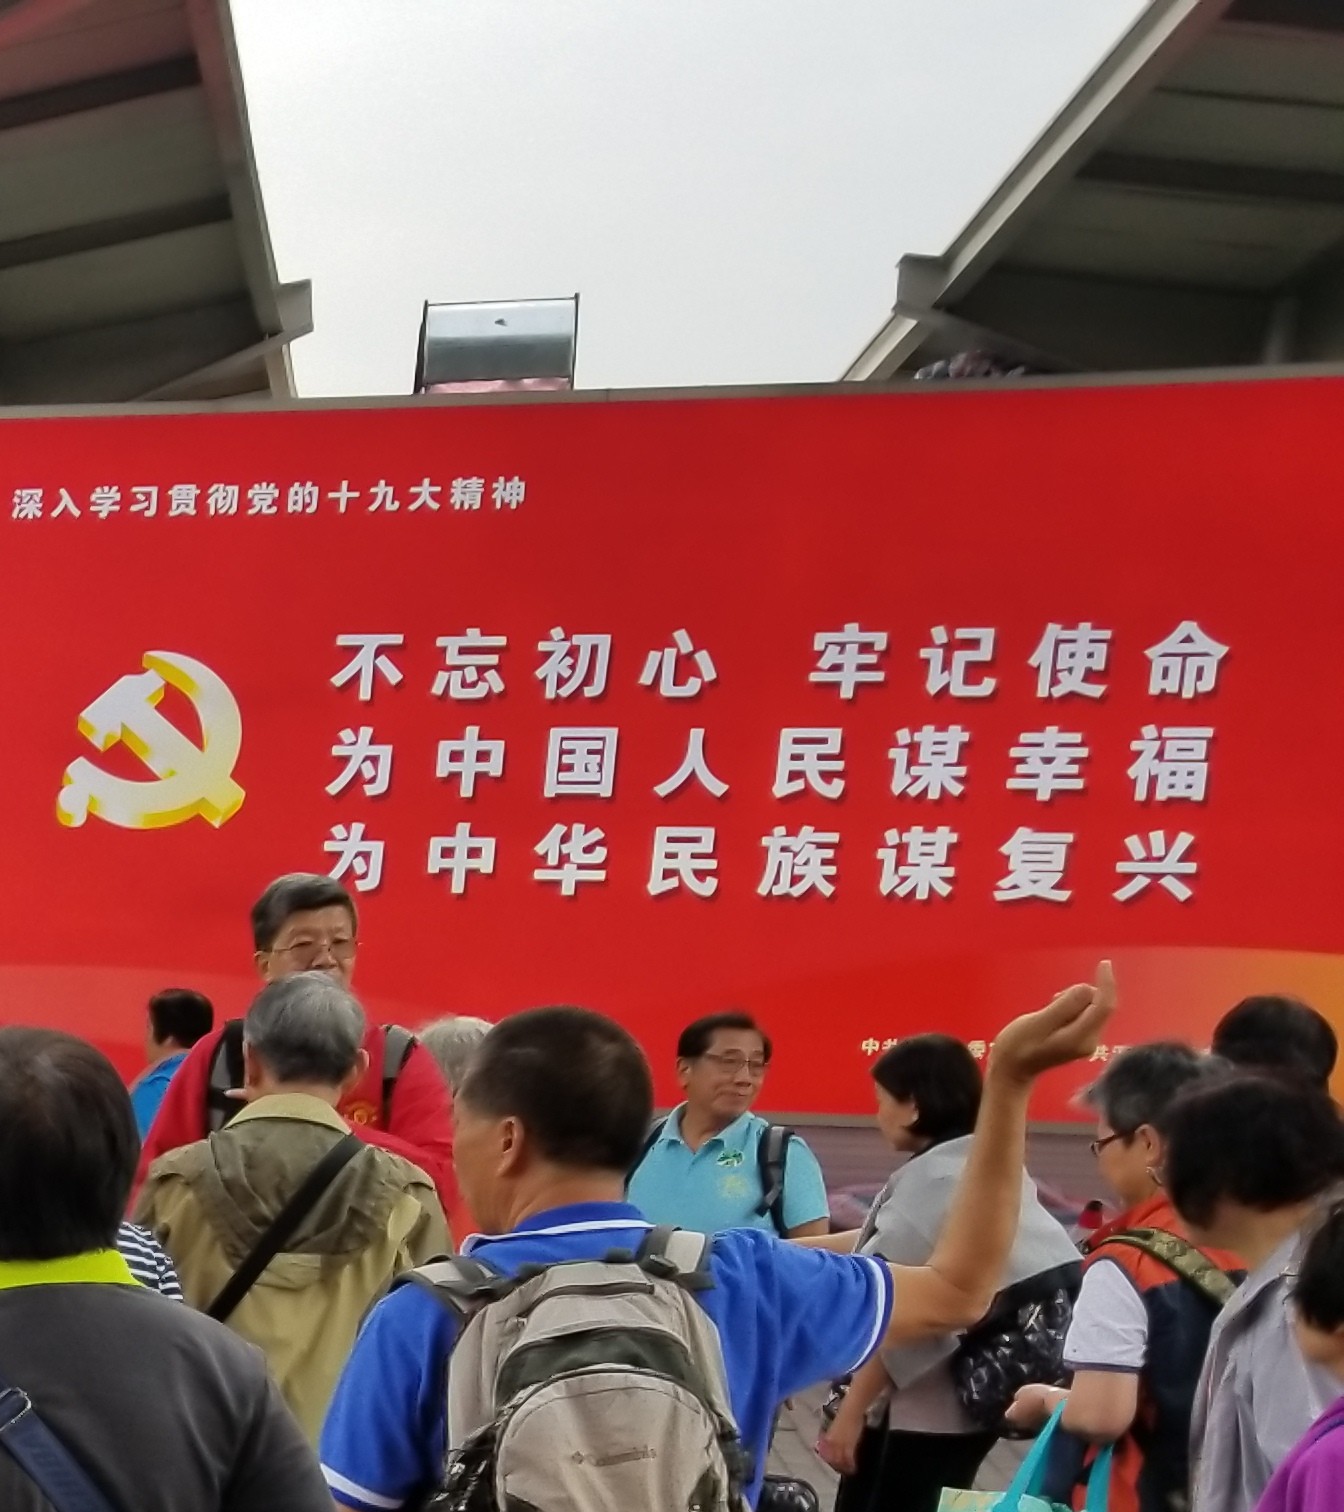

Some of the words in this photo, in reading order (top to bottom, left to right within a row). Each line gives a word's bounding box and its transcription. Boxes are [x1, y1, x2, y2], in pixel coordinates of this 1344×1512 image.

[11, 475, 527, 521] 深入学习贯彻党的十九大精神
[330, 625, 717, 706] 不忘初心
[807, 620, 1230, 702] 牢记使命
[324, 722, 1215, 804] 为中国人民谋幸福
[322, 822, 1200, 904] 为中华民族谋复兴
